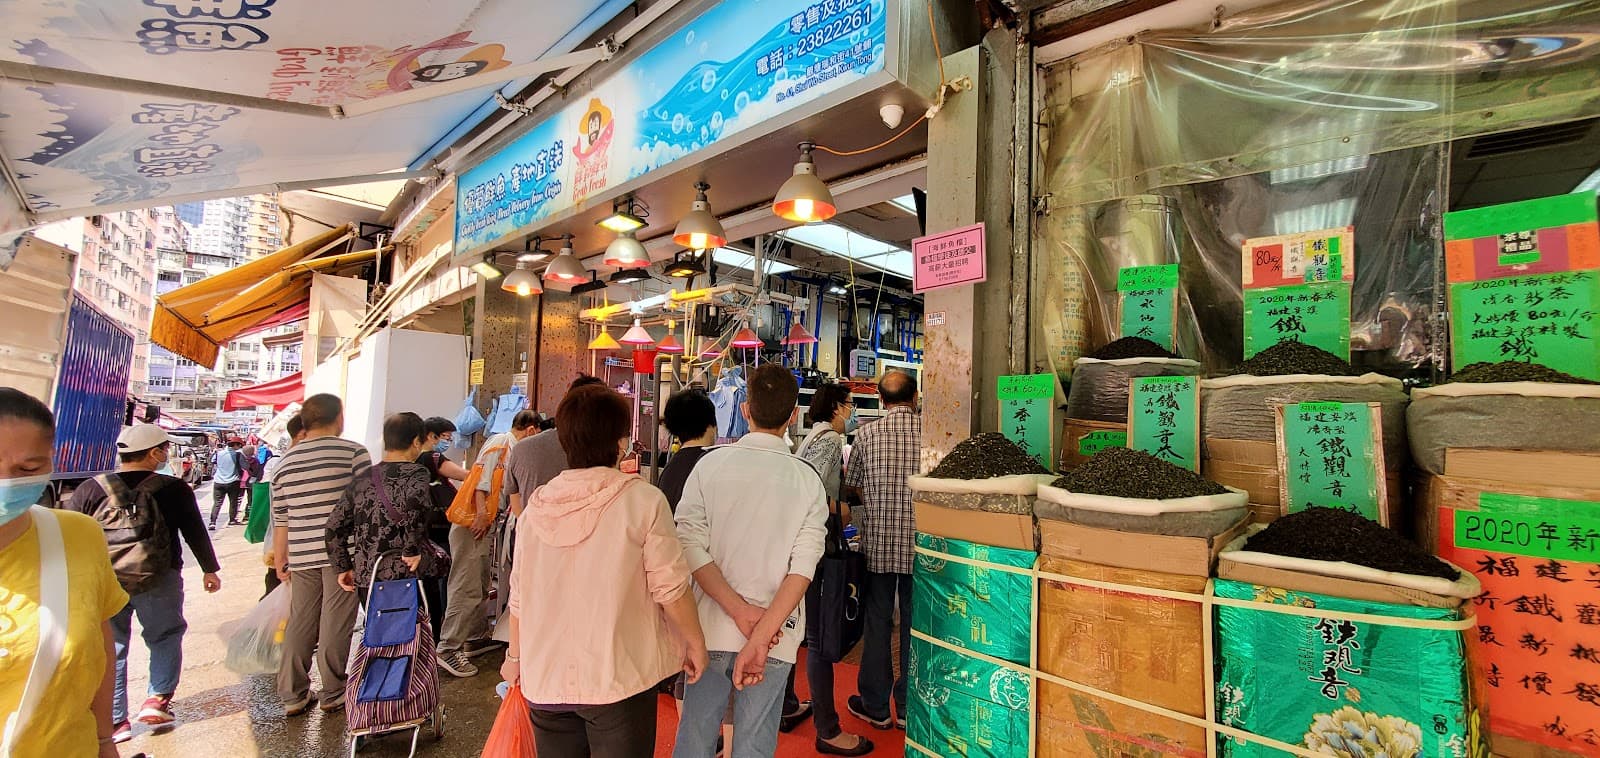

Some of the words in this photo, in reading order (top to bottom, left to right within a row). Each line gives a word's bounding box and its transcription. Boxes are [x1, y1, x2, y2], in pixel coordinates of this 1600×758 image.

[272, 47, 322, 78] Grab
[857, 52, 873, 67] Tong
[266, 80, 311, 100] Fre
[510, 140, 563, 194] 產地直送
[1151, 391, 1185, 460] 鐵觀音茶
[1299, 411, 1358, 423] 福建安溪
[1315, 436, 1353, 498] 鐵觀音
[1465, 515, 1600, 552] 2020年新
